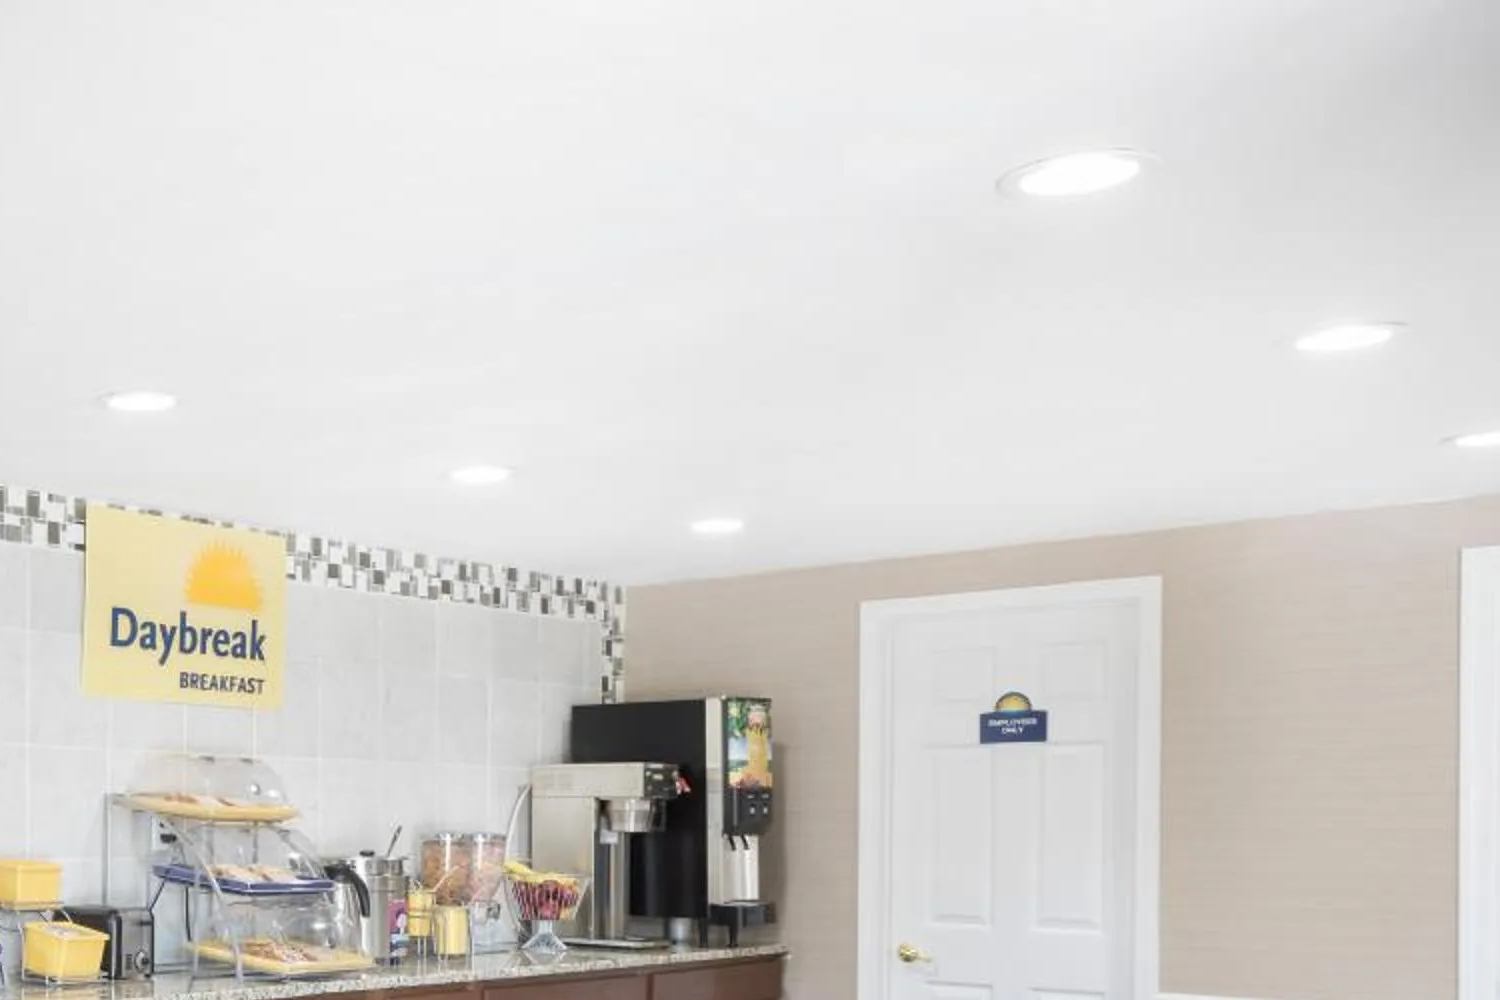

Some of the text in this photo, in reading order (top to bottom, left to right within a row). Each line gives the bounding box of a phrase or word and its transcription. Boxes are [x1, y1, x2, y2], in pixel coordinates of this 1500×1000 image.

[110, 607, 266, 666] Daybreak
[179, 671, 265, 694] BREAKFAST
[1001, 727, 1023, 735] ONLY
